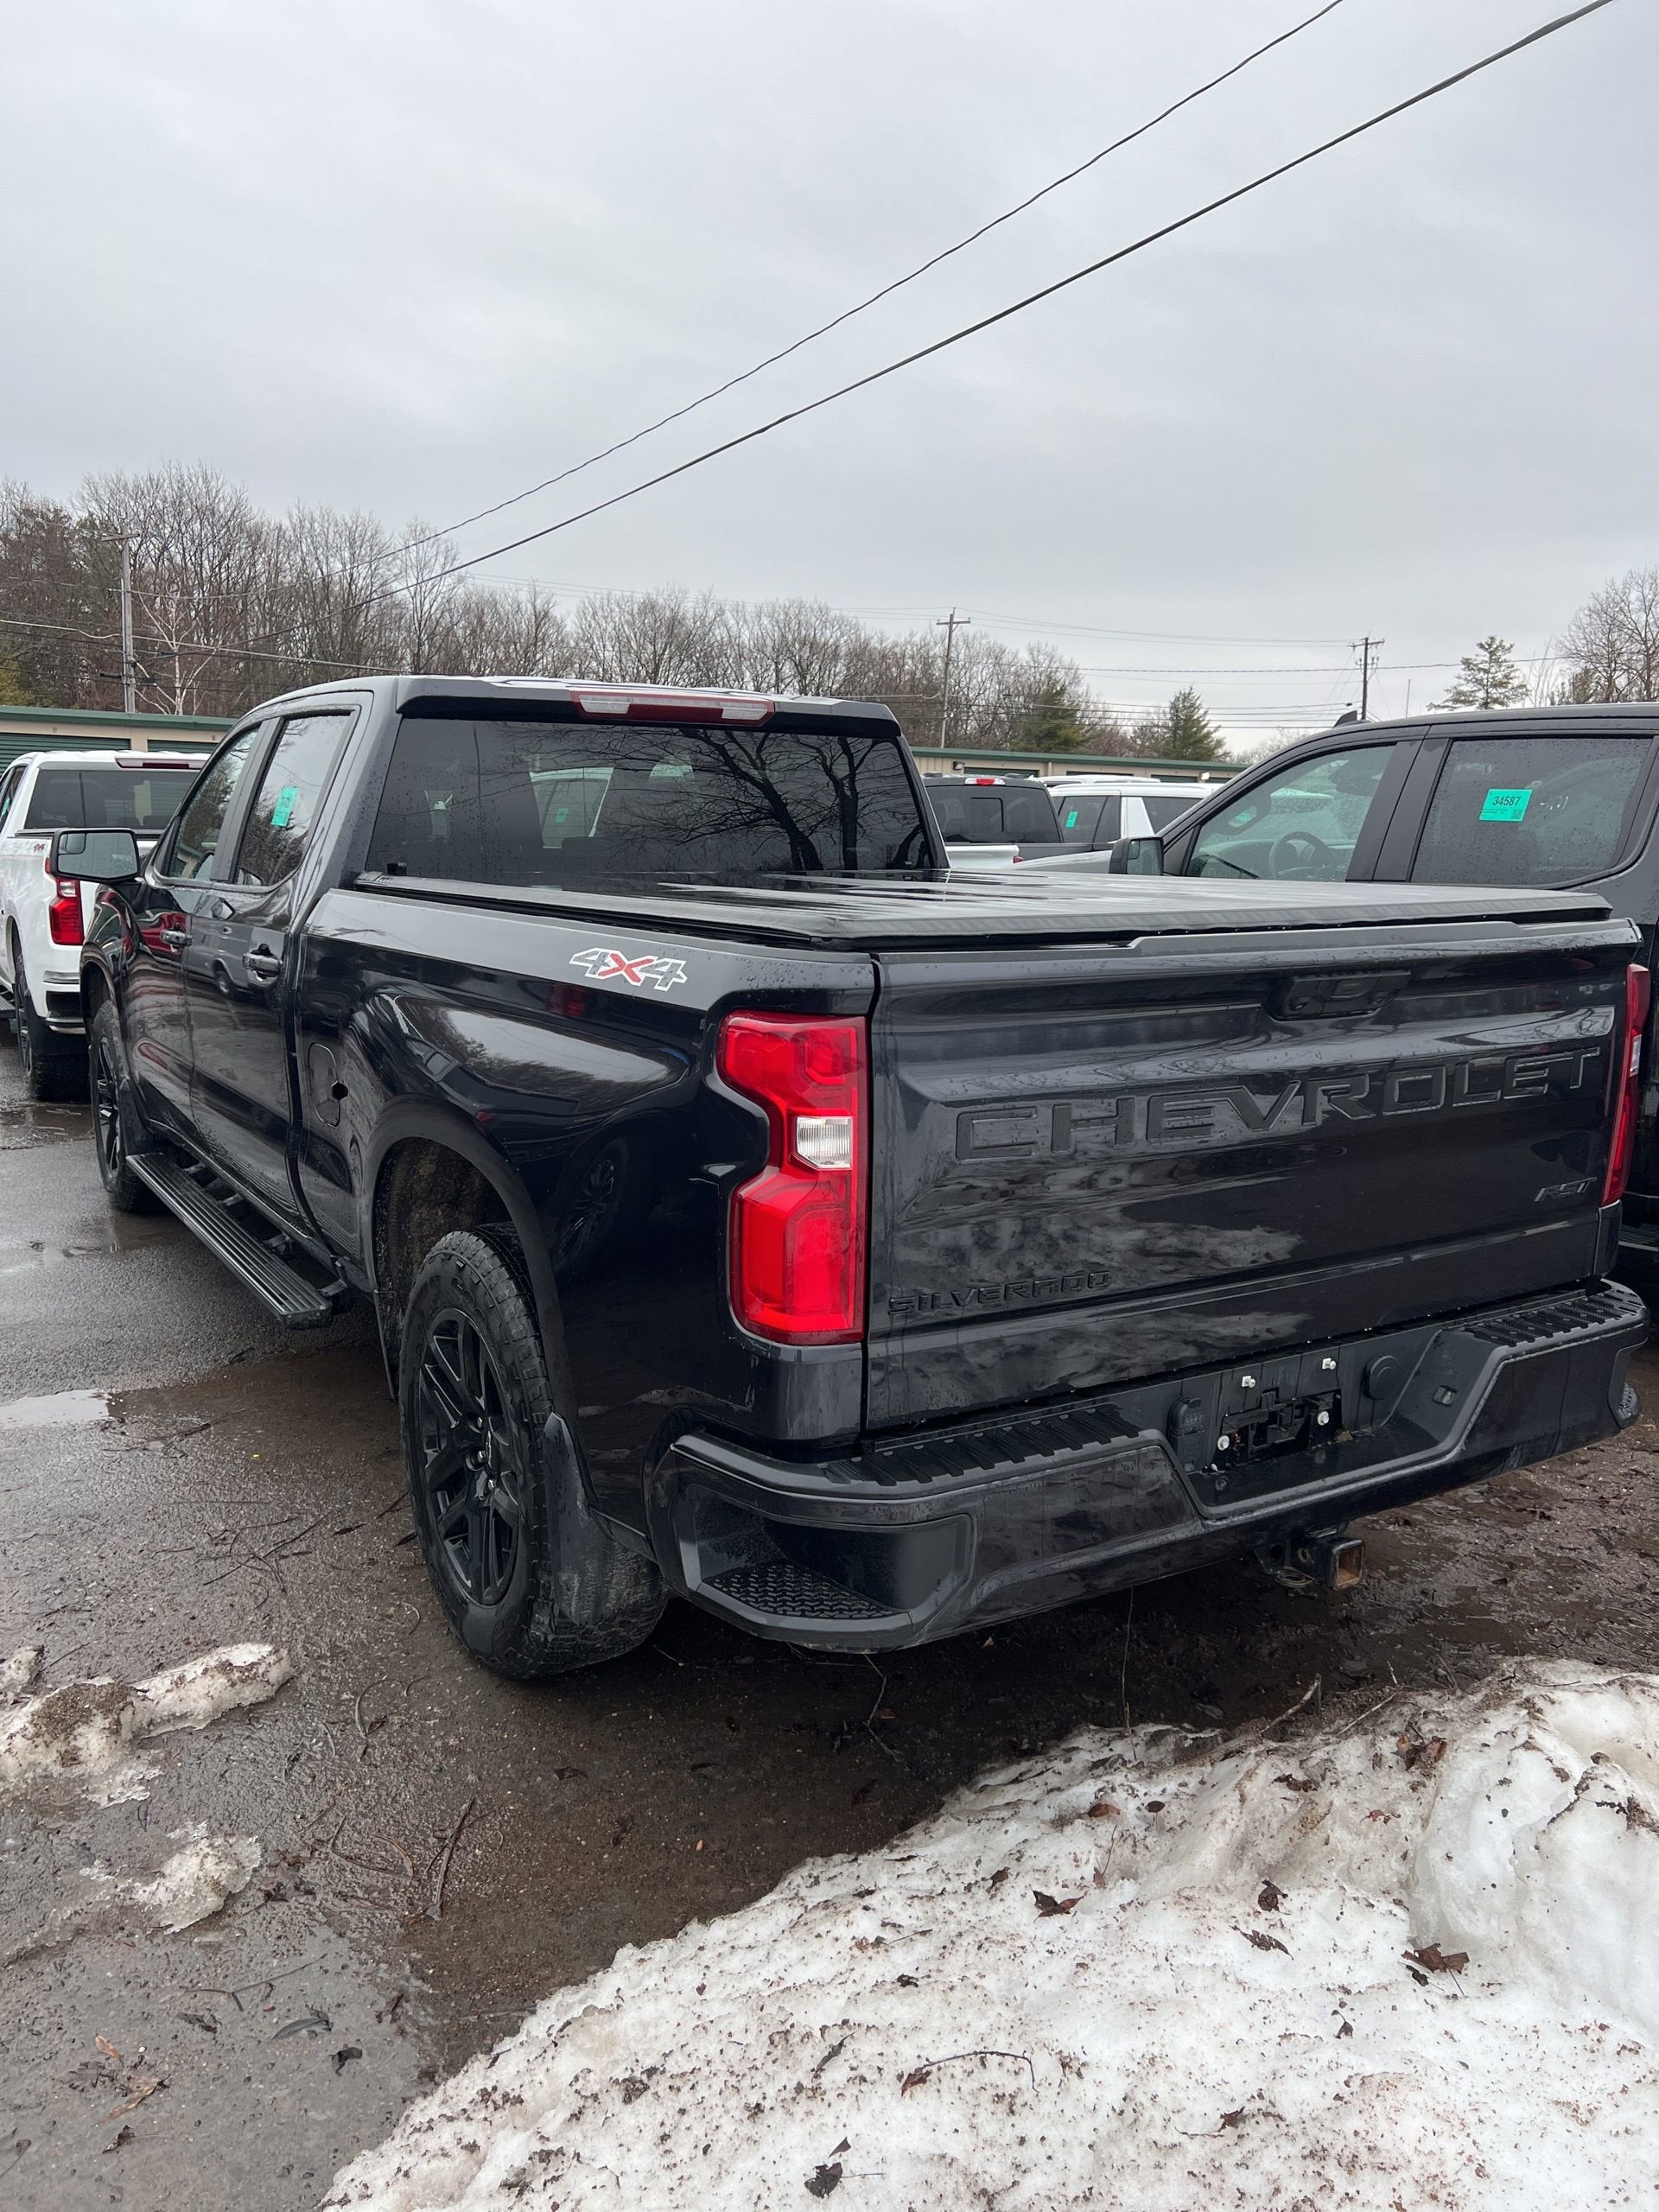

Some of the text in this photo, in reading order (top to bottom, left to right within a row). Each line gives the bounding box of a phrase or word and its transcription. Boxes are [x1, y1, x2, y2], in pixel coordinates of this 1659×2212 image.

[1493, 796, 1522, 806] 34587
[955, 1046, 1602, 1164] CHEVROLET
[1535, 1177, 1598, 1202] RST
[887, 1270, 1112, 1316] SILVERADO
